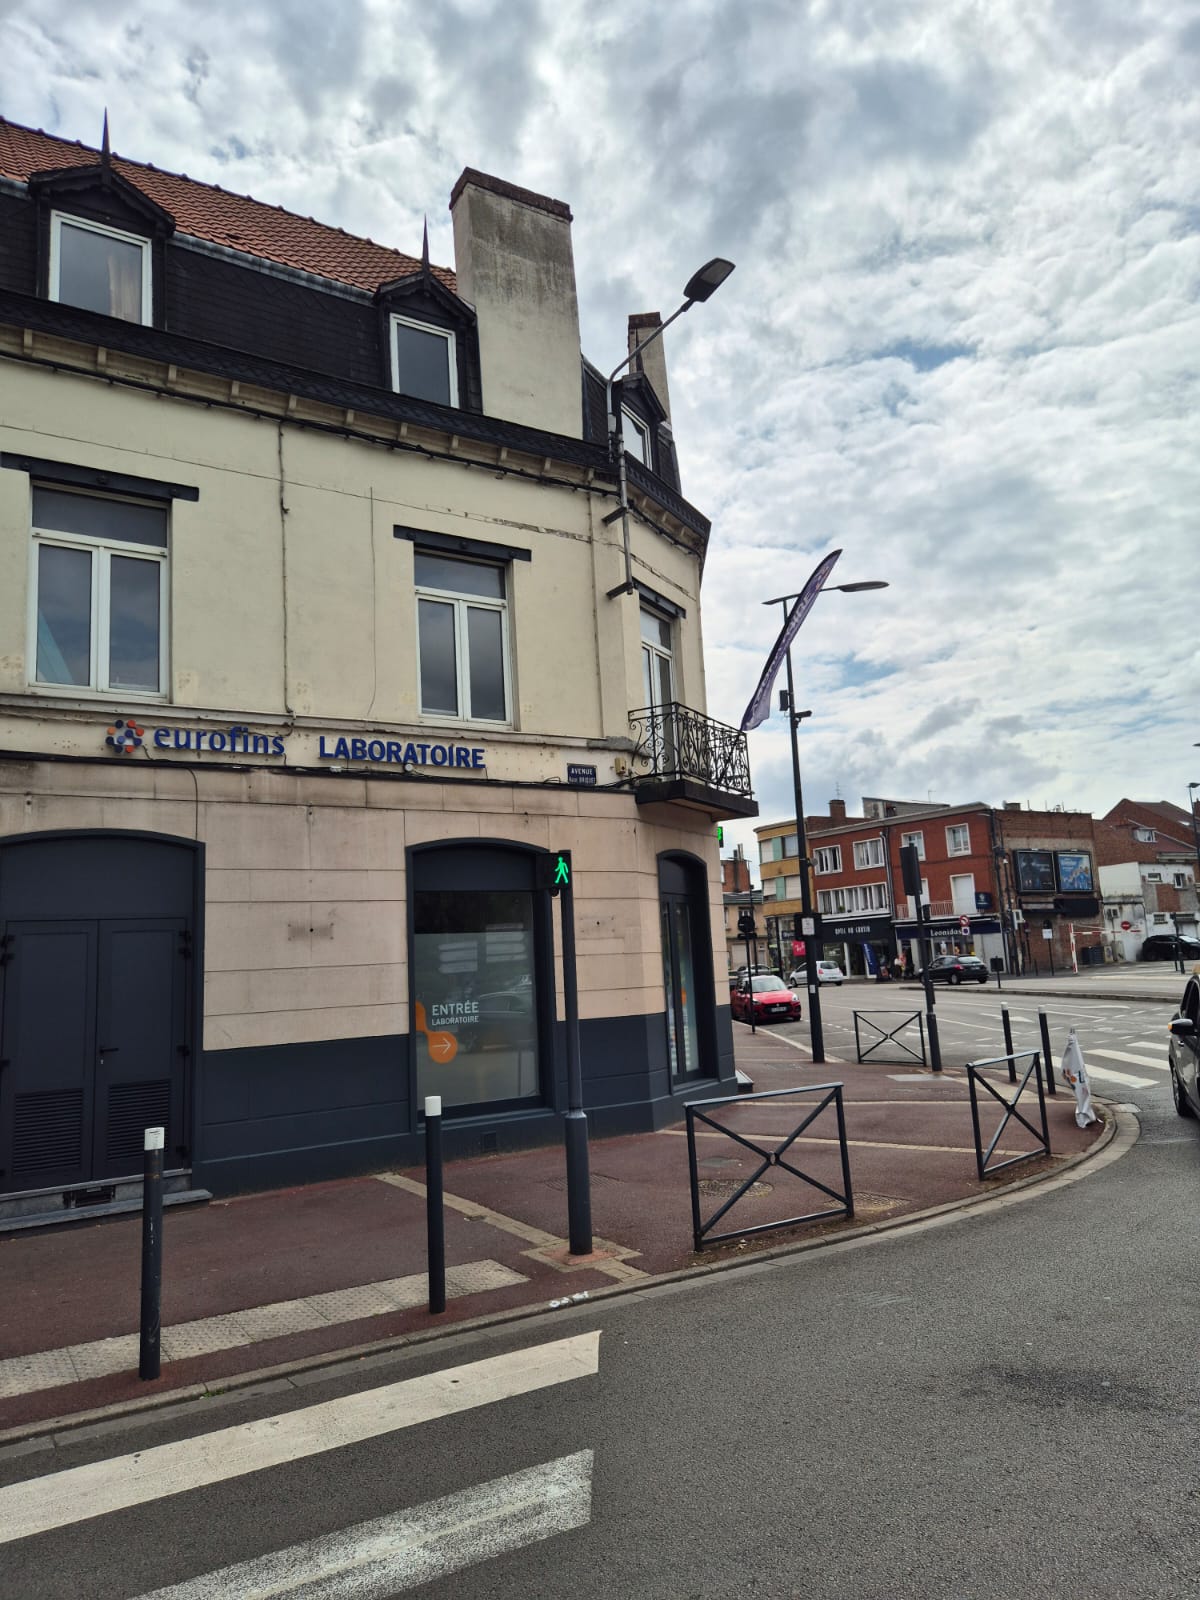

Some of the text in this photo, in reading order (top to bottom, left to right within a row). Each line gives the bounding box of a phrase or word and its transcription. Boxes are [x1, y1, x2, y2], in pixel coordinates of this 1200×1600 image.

[154, 726, 285, 755] eurofins
[319, 735, 486, 768] LABORATOIRE
[930, 928, 962, 937] Leonidas
[432, 1000, 480, 1016] ENTRÉE
[432, 1016, 479, 1025] LABORATOIRE
